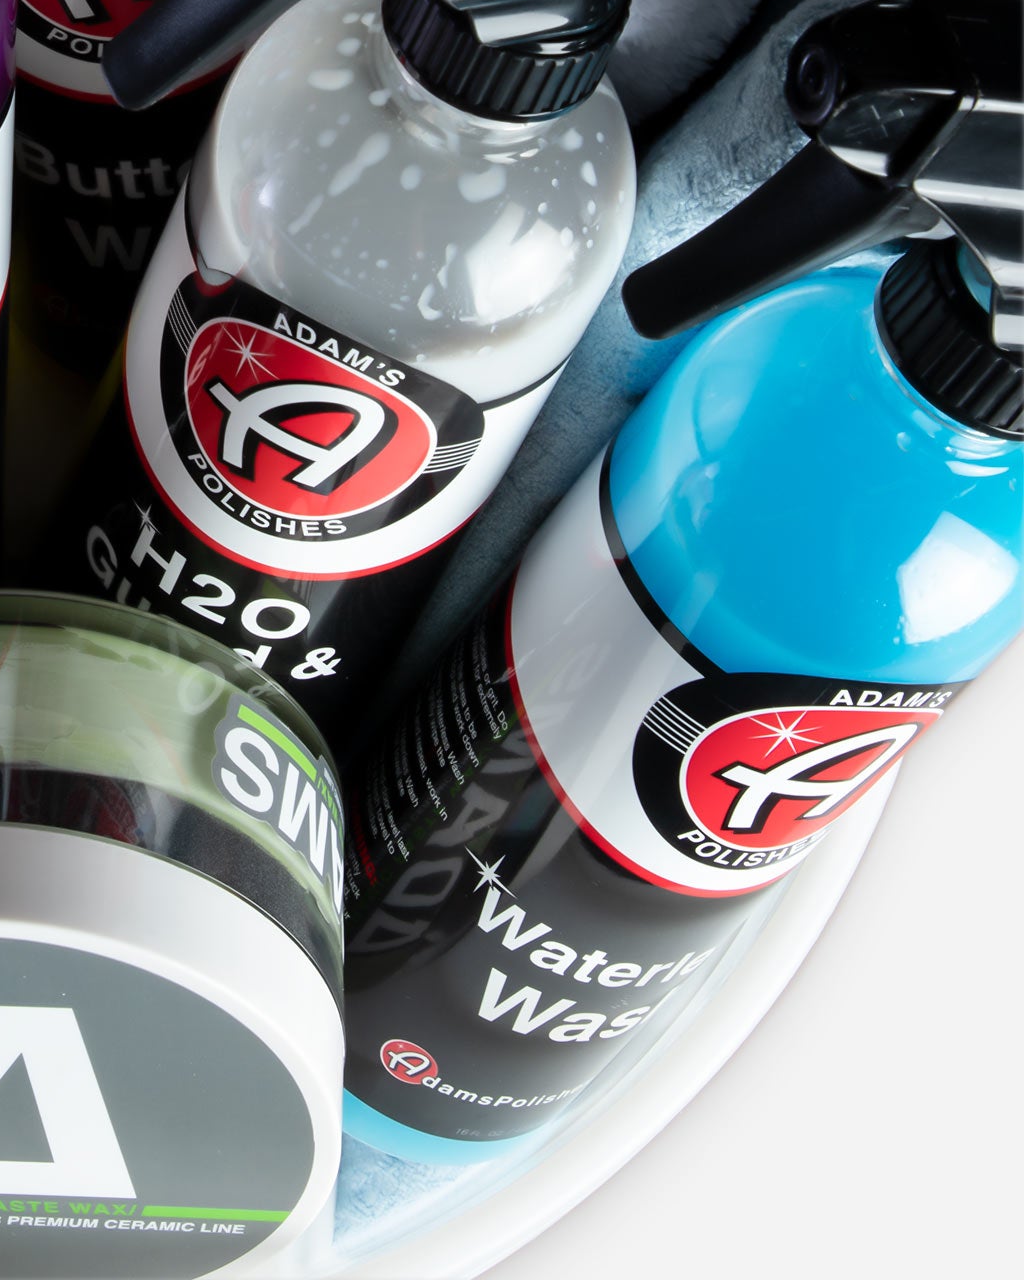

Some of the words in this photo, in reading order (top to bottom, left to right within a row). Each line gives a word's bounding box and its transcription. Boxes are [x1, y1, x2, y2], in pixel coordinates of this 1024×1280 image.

[273, 312, 406, 388] ADAM'S
[187, 452, 348, 538] POLISHES
[130, 523, 311, 640] H2O
[290, 646, 342, 680] &
[478, 683, 502, 740] extremely
[830, 689, 954, 708] ADAM'S
[497, 710, 507, 731] Do
[448, 750, 464, 786] Wash
[462, 733, 480, 768] down
[426, 778, 441, 809] work
[439, 806, 448, 822] in
[7, 1215, 99, 1229] PREMIUM
[104, 1219, 195, 1232] CERAMIC
[200, 1223, 246, 1234] LINE
